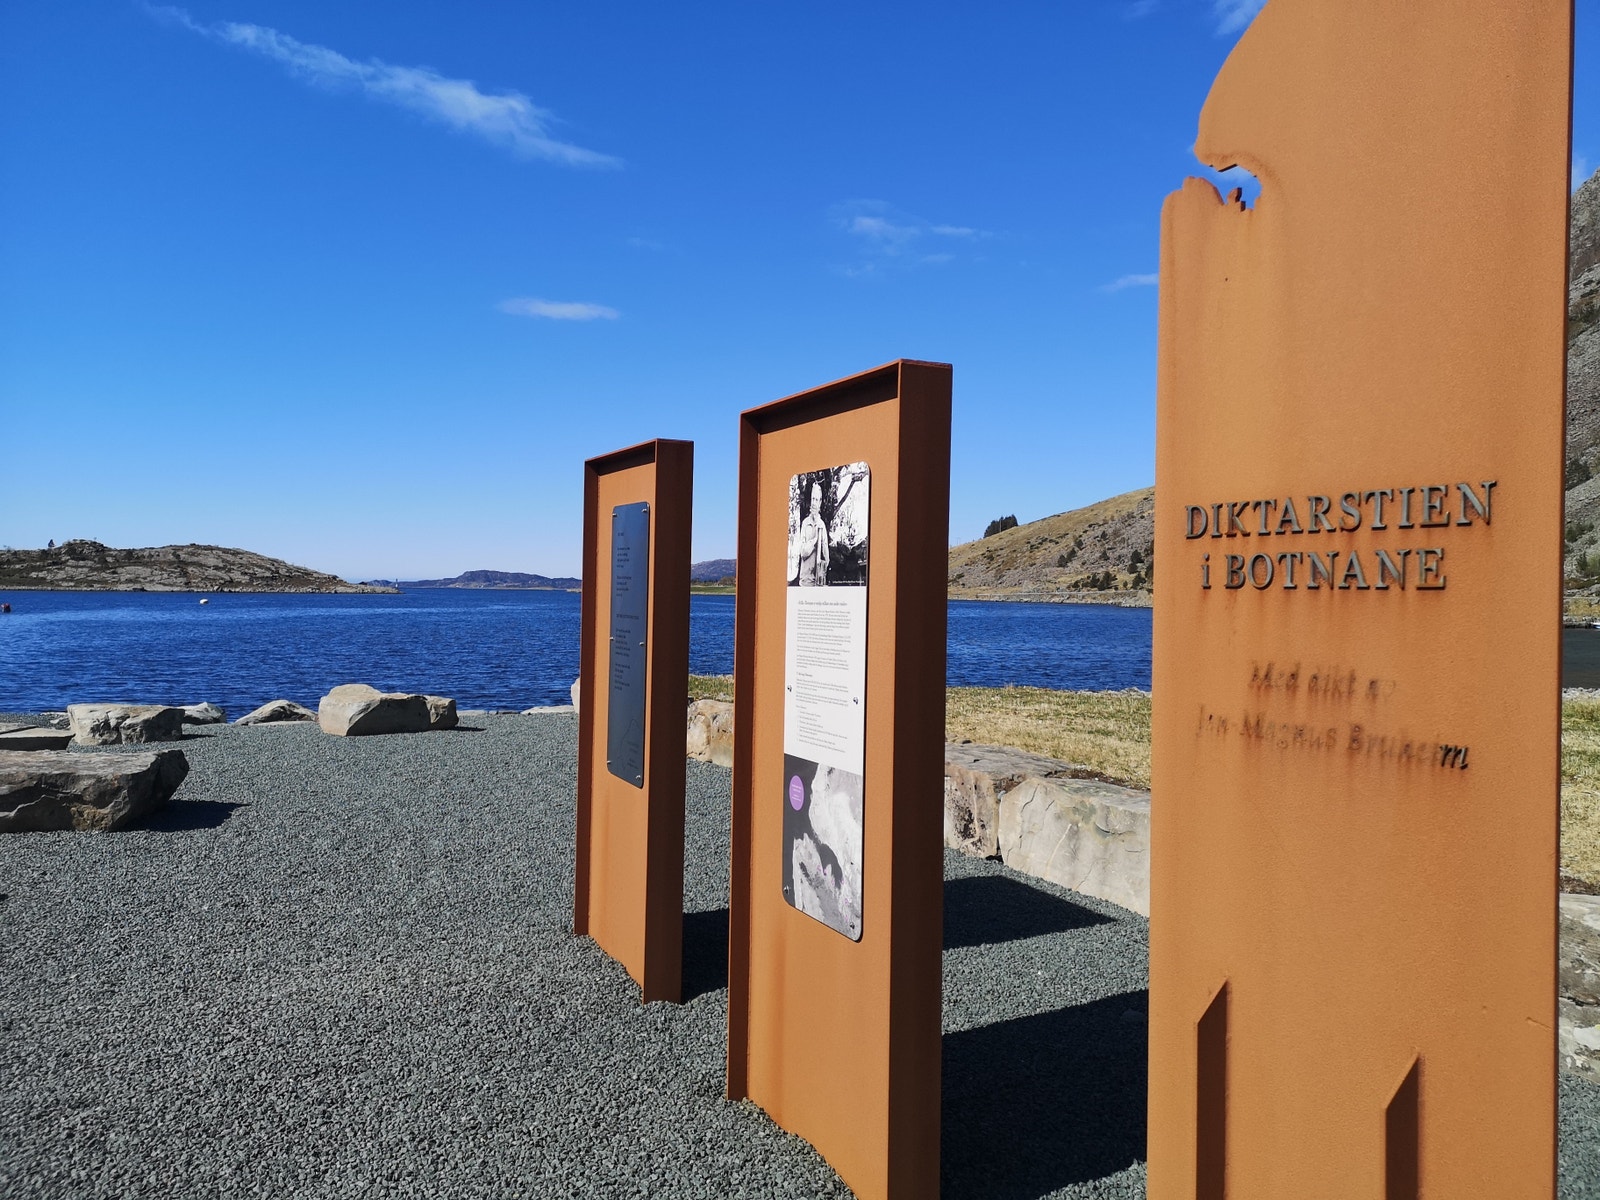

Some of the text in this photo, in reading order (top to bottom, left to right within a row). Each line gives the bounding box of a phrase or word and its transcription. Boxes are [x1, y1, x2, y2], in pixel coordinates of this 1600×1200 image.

[1185, 480, 1497, 539] DIKTARSTIEN
[1201, 547, 1447, 590] i BOTNANE
